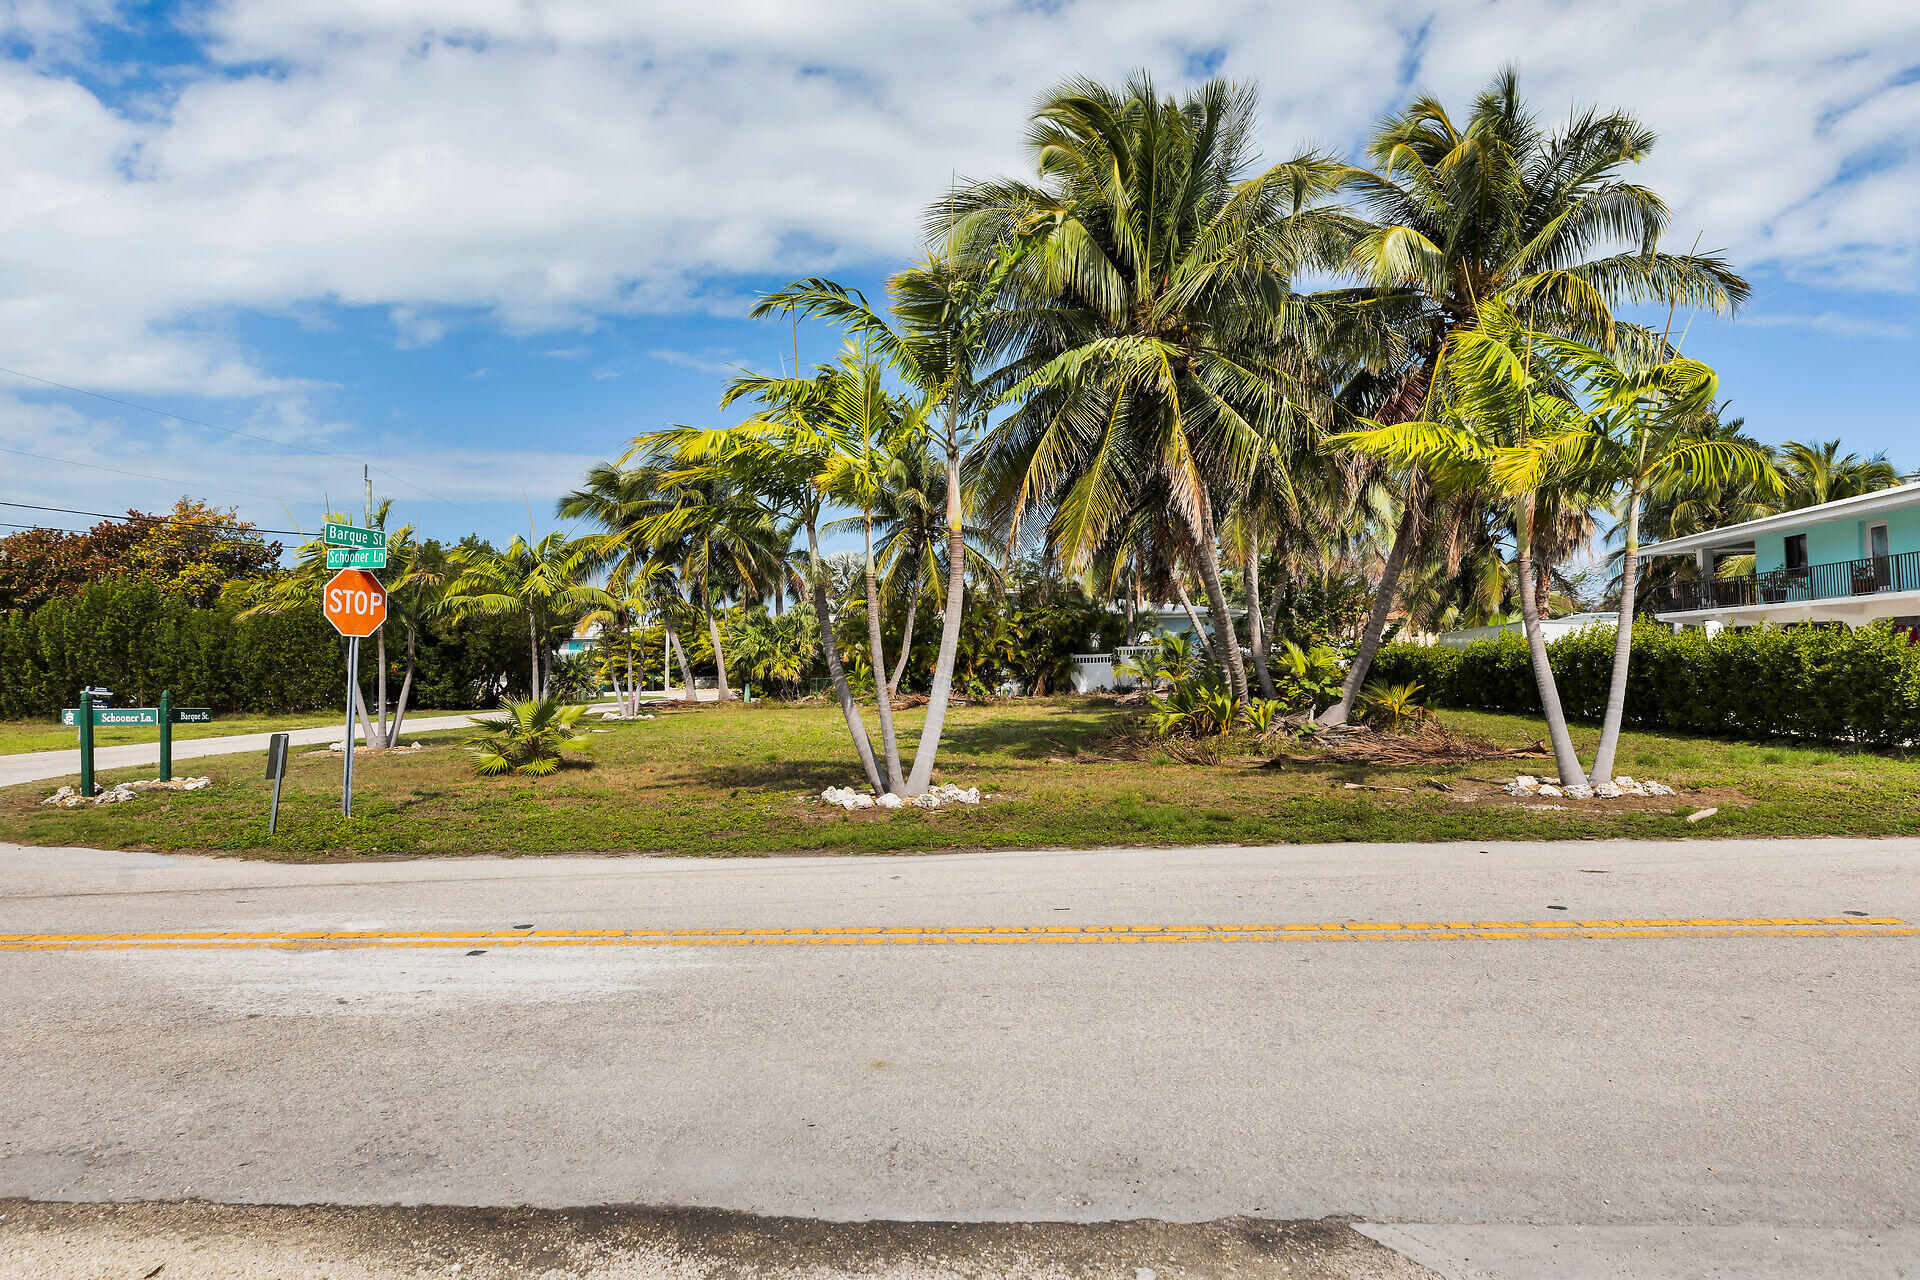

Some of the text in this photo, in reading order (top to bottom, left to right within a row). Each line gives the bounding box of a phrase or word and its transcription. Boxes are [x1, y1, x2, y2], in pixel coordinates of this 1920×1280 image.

[330, 525, 383, 546] Barque St
[329, 549, 384, 563] Schooner Ln
[329, 588, 383, 616] STOP
[101, 712, 154, 723] Schooner Ln.
[180, 711, 210, 722] Barque St.
